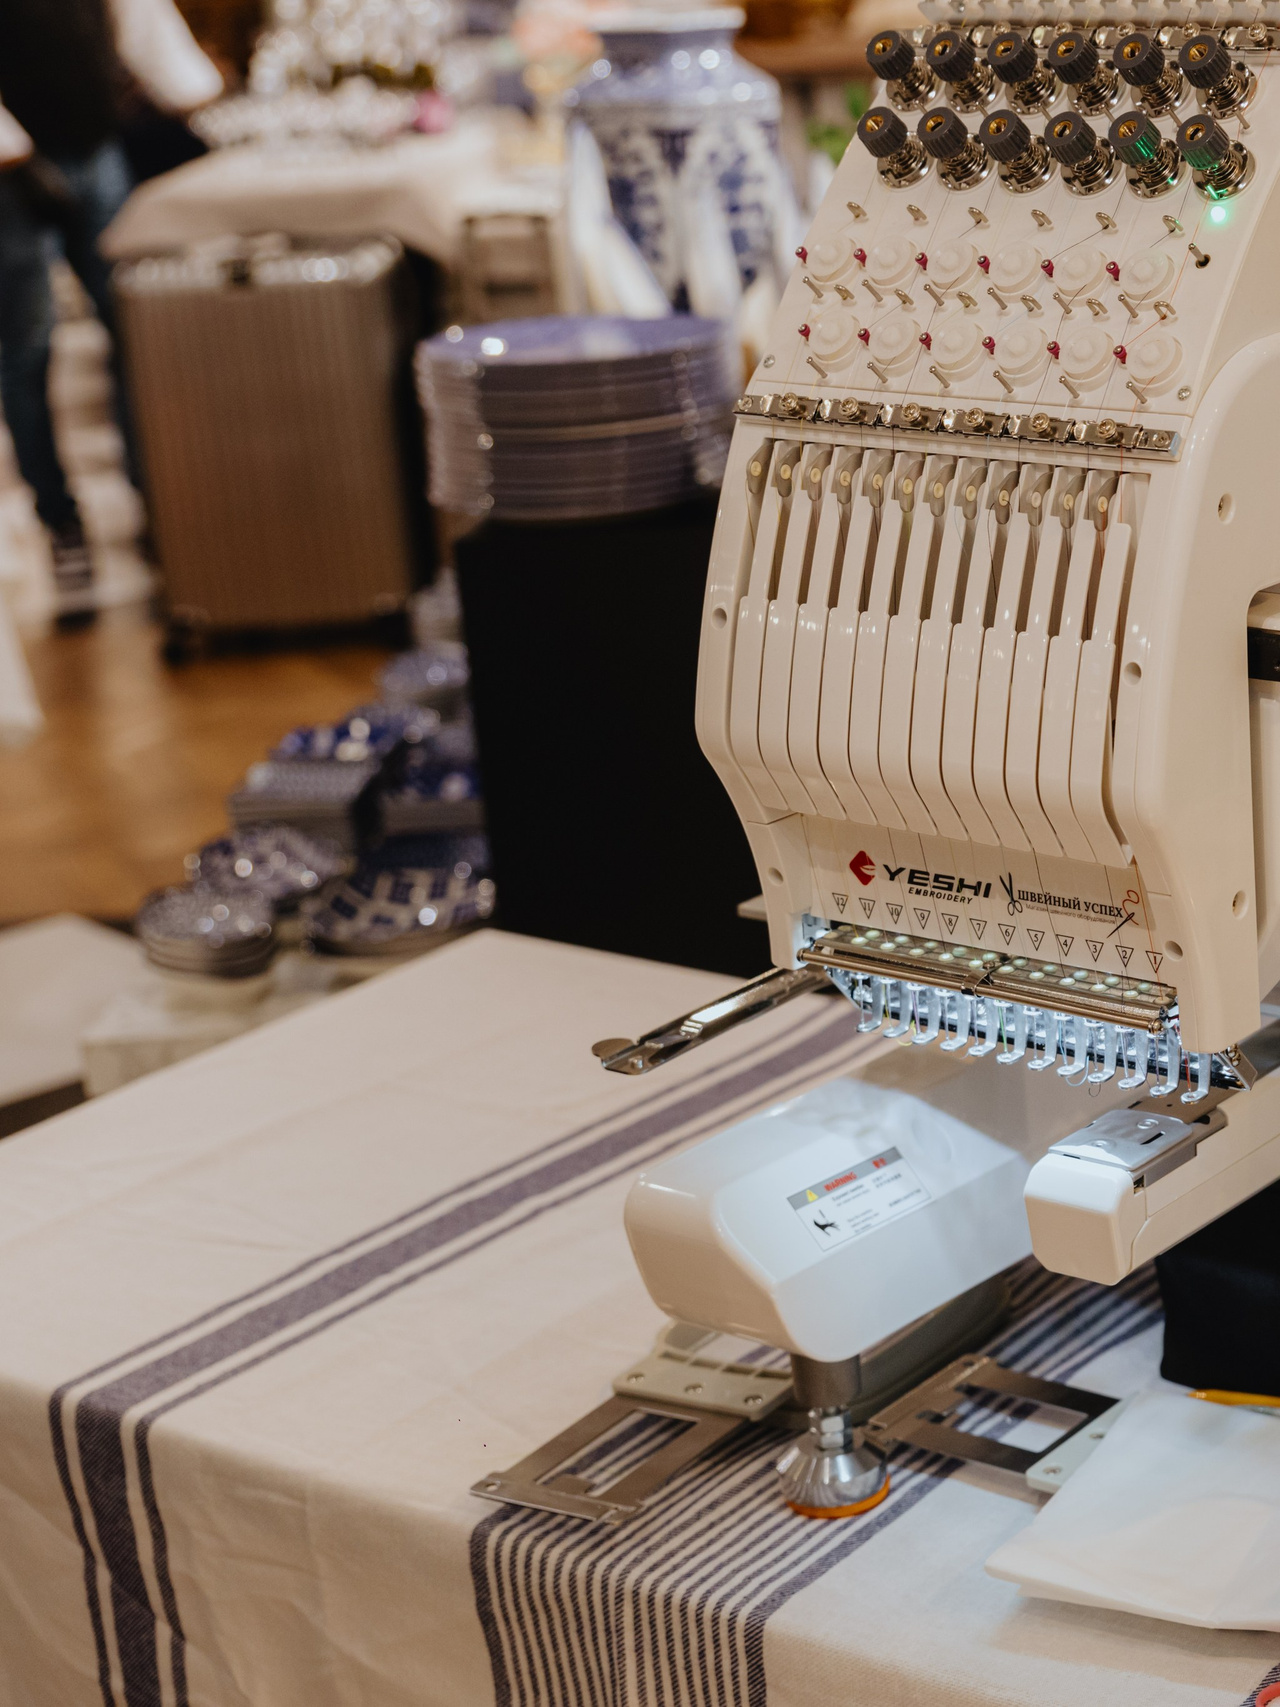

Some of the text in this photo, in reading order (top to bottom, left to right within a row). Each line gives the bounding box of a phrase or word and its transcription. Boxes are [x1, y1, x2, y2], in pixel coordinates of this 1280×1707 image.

[882, 864, 992, 898] YESHI
[908, 887, 973, 904] EMBROIDERY
[1017, 889, 1124, 918] ШВЕЙНЫЙ УСПЕХ
[823, 1171, 858, 1192] WARNING
